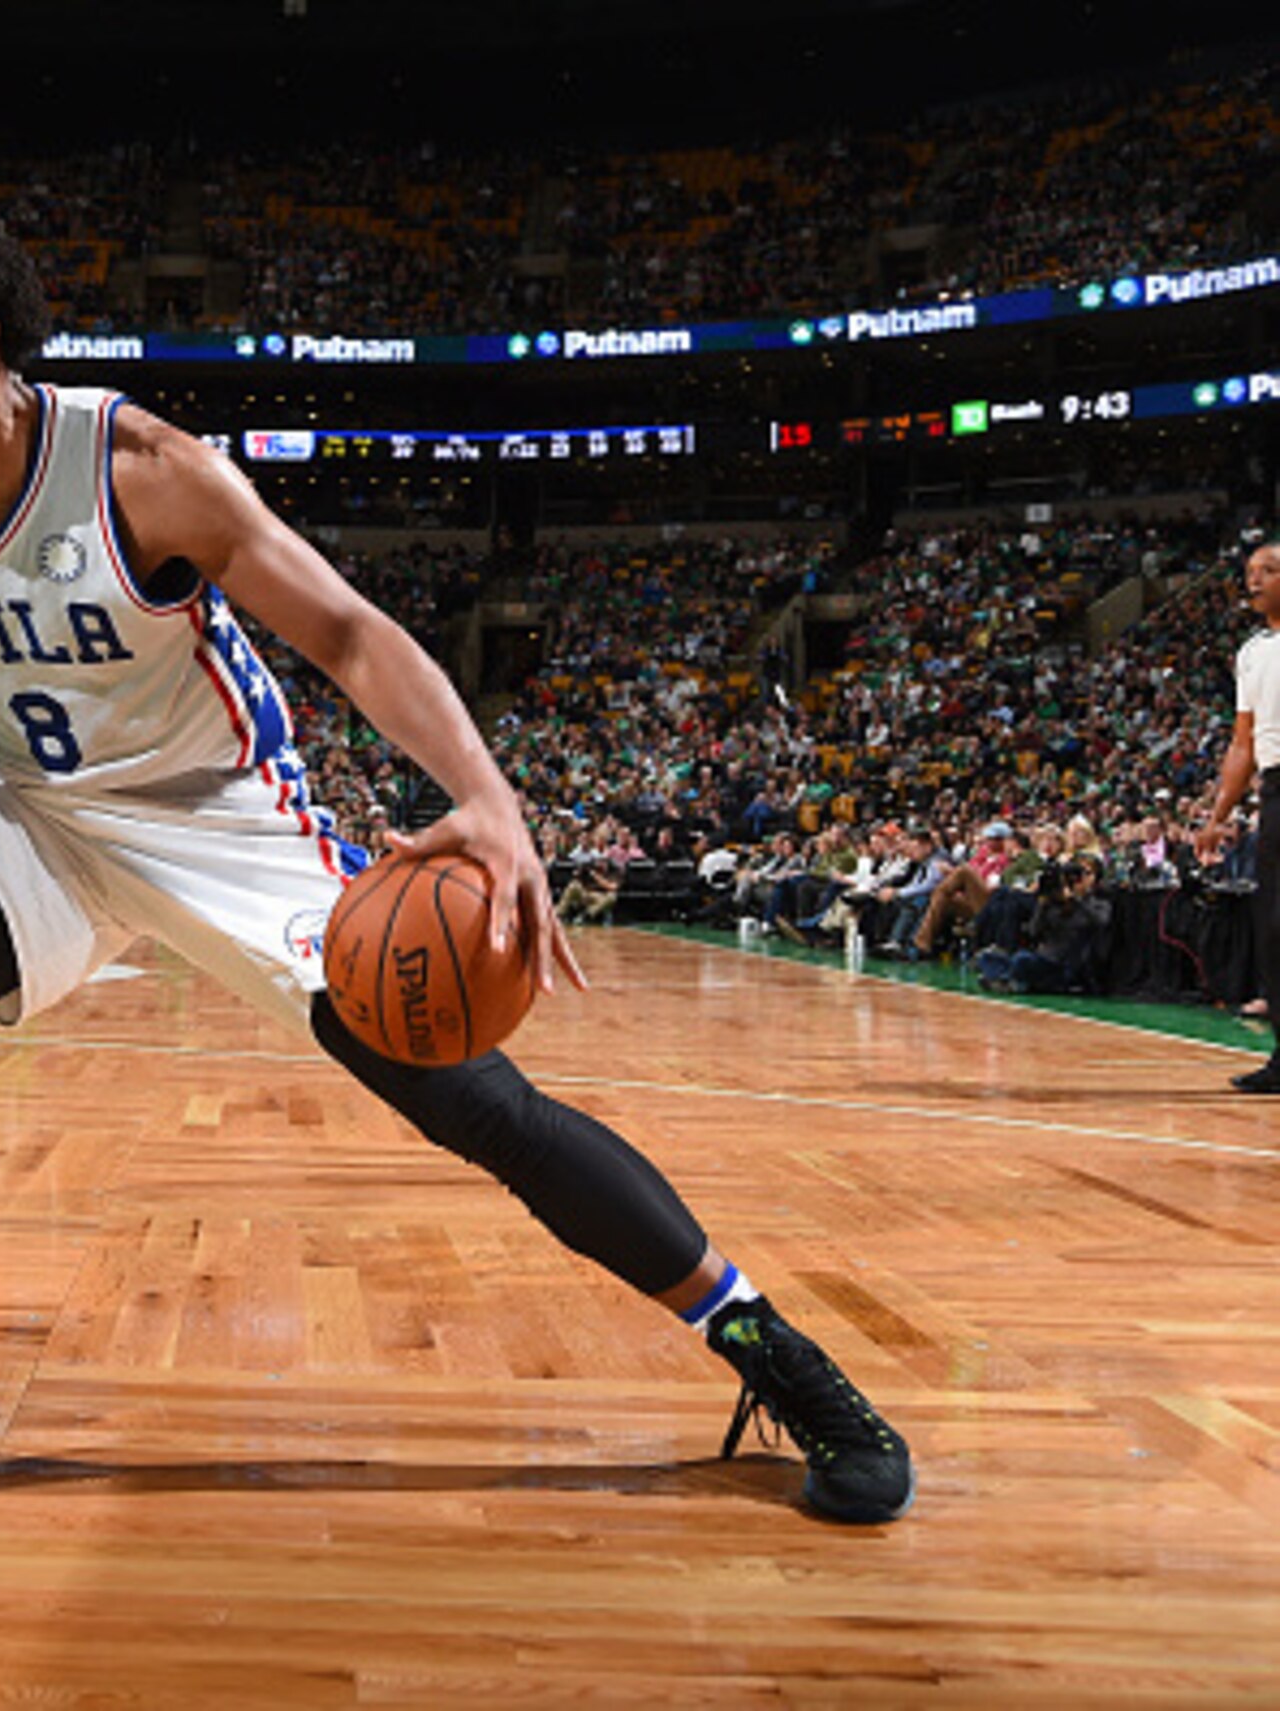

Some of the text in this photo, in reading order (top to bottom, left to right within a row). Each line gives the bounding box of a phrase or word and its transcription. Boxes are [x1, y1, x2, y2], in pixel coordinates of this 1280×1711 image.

[1146, 258, 1277, 304] Putnam
[849, 304, 975, 341] Putnam
[293, 335, 414, 362] Putnam
[564, 328, 690, 358] Putnam
[1061, 391, 1130, 423] 9:43
[8, 691, 82, 773] 8
